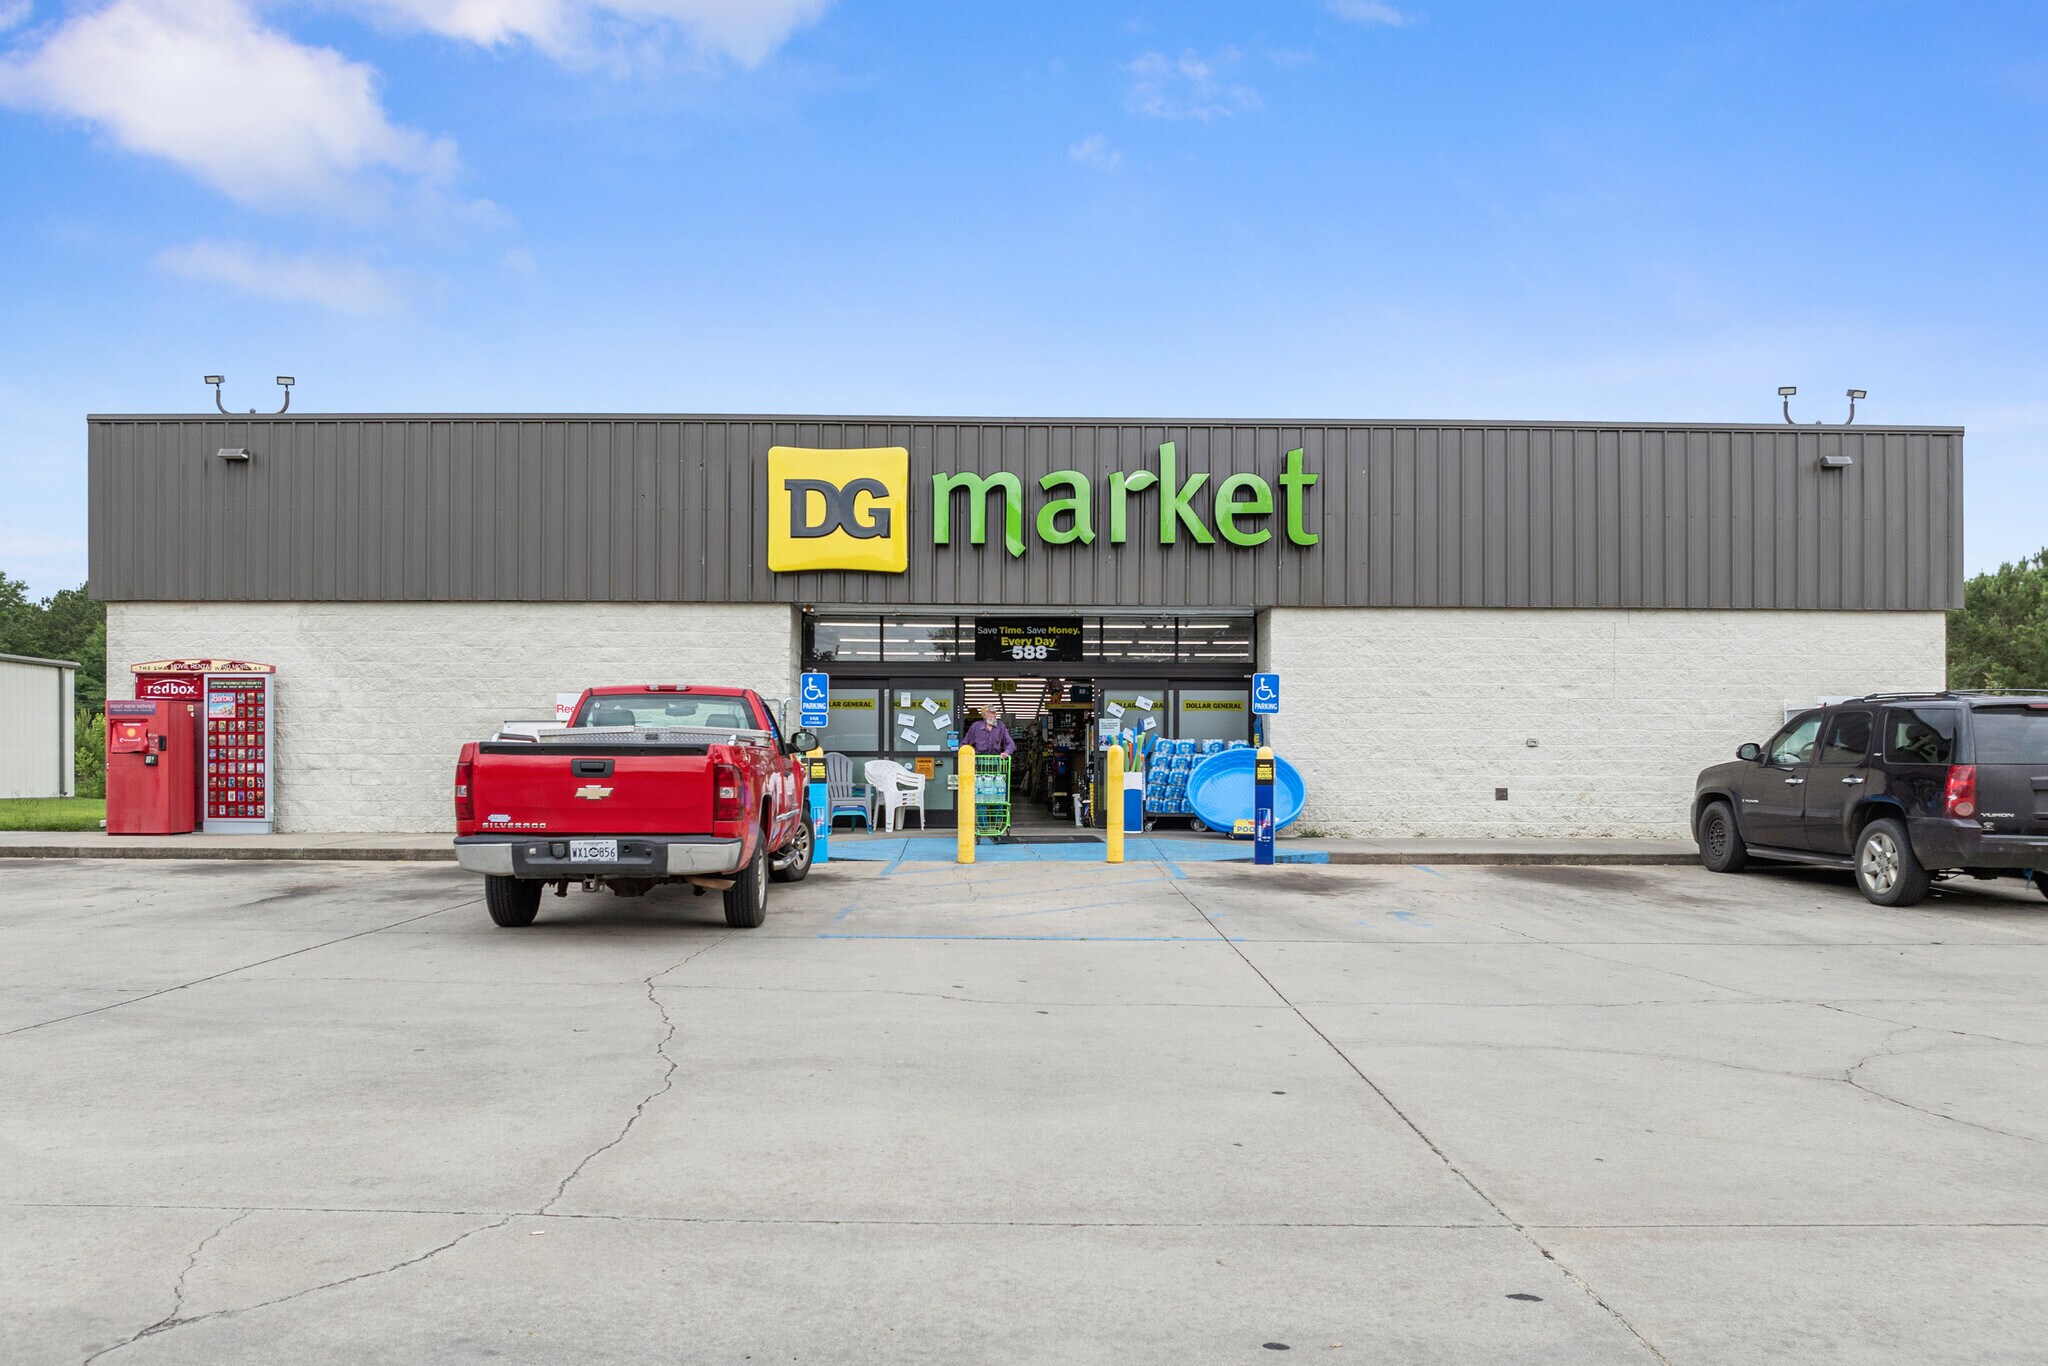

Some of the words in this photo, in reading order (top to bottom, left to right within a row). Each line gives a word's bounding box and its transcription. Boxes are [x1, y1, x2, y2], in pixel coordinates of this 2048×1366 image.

[931, 441, 1320, 558] market
[784, 477, 892, 540] DG
[977, 626, 998, 634] Save
[999, 626, 1025, 634] Time.
[1026, 626, 1047, 634] Save
[1048, 626, 1080, 636] Money.
[1001, 636, 1032, 646] Every
[1011, 645, 1048, 660] 588
[802, 702, 827, 710] PARKING
[1254, 702, 1278, 710] PARKING
